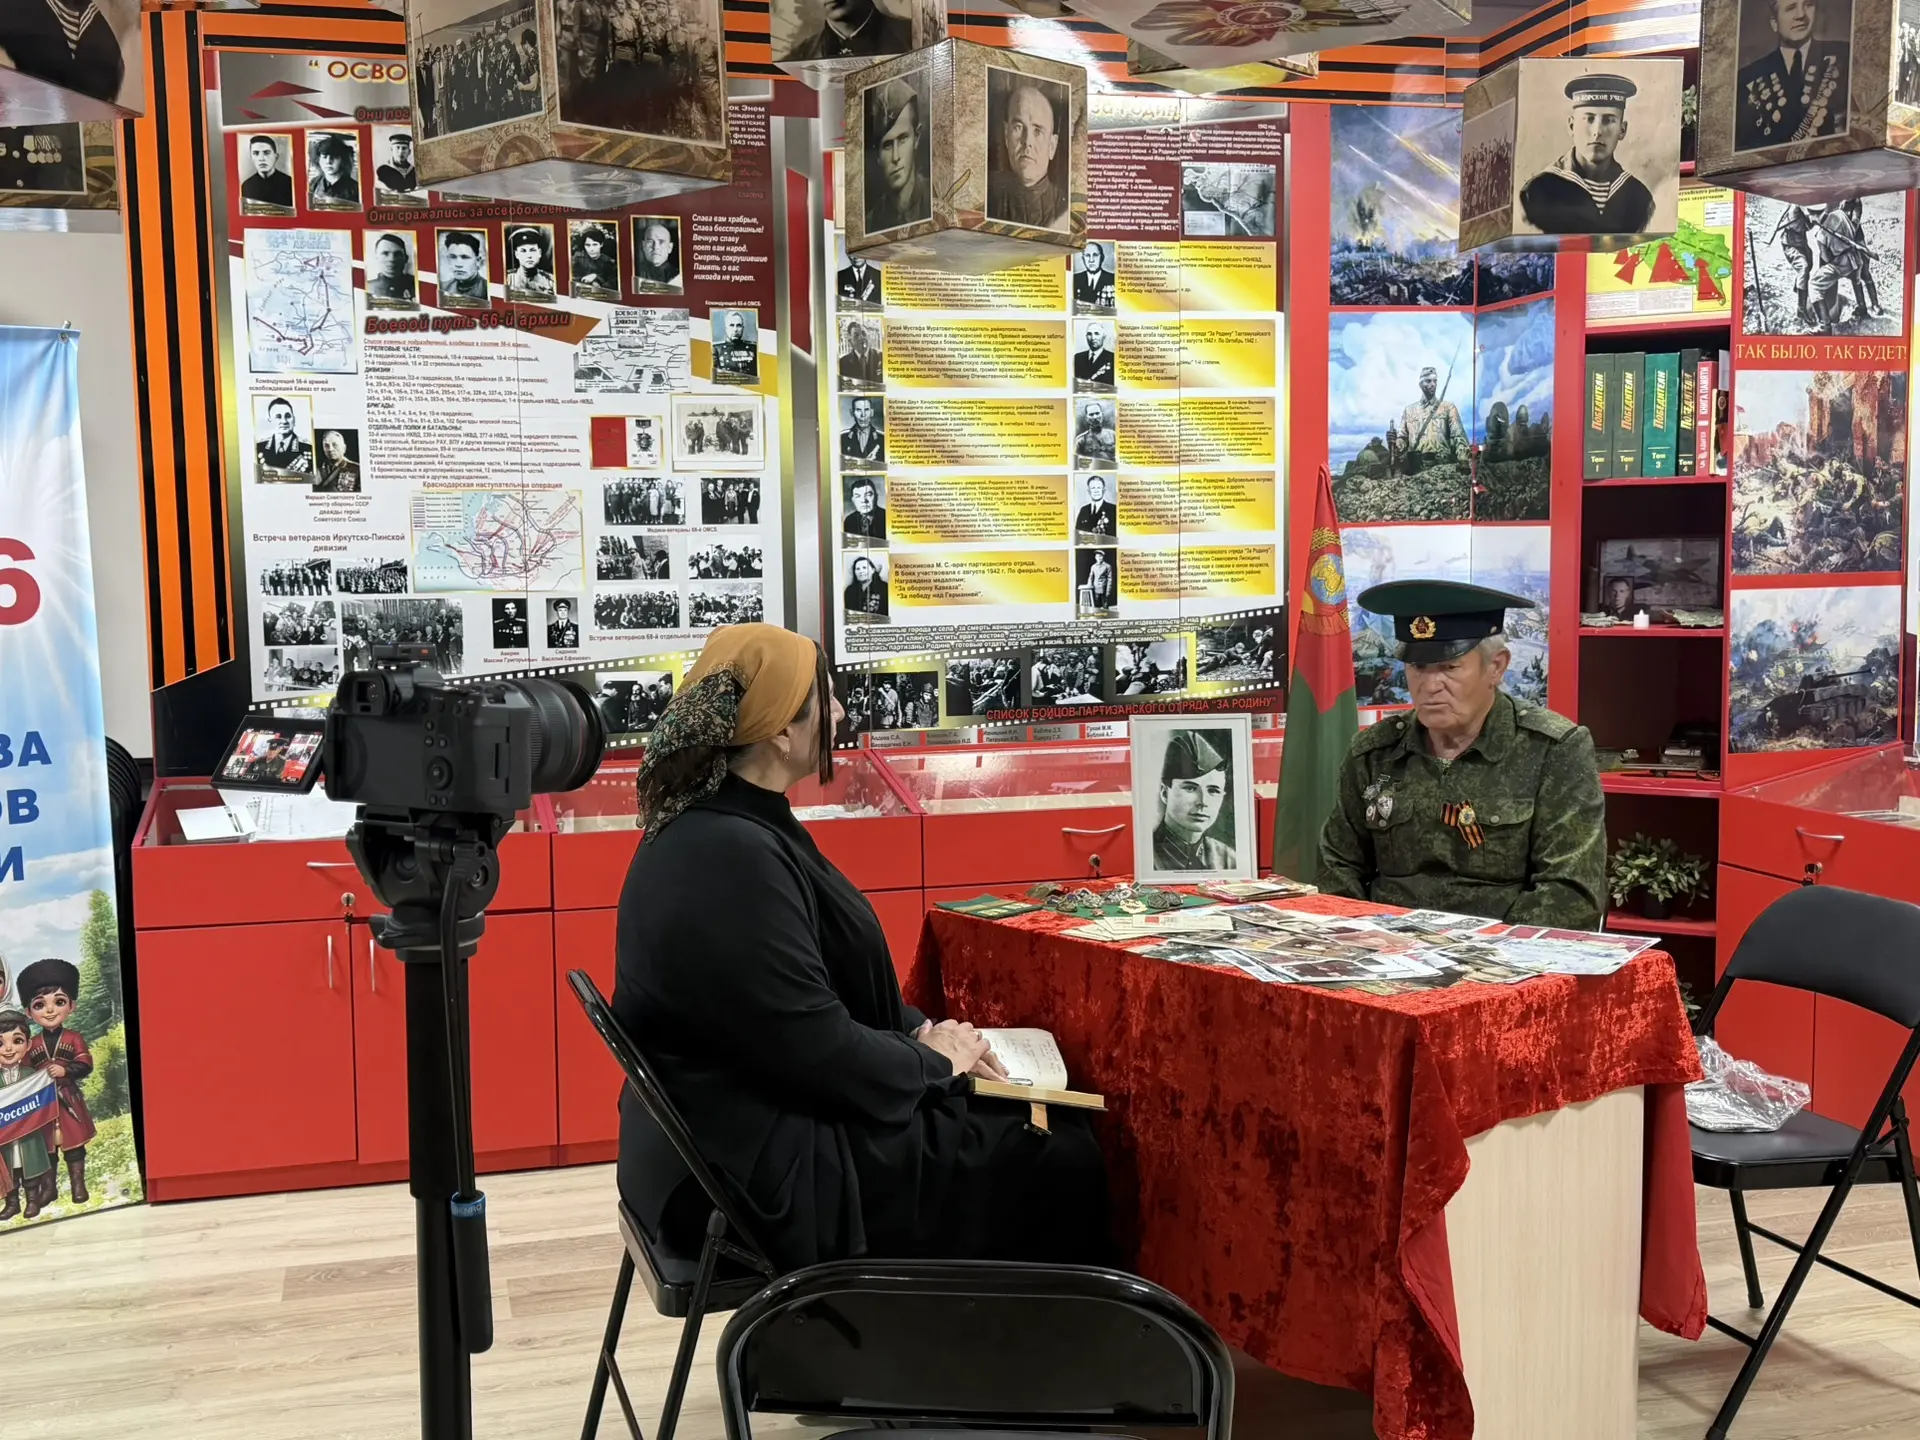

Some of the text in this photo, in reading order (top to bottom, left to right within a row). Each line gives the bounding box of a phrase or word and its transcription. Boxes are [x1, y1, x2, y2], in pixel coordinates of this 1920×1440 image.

[366, 312, 570, 334] Боевой путь 56-й армии
[1736, 343, 1907, 361] ТАК БЫЛО. ТАК БУДЕТ!
[1700, 366, 1708, 414] КНИГА ПАМЯТИ
[253, 534, 286, 542] Встреча
[333, 533, 405, 542] Иркутско-Пинской
[986, 697, 1276, 721] СПИСОК БОЙЦОВ ПАРТИЗАНСКОГО ОТРЯДА "ЗА РОДИНУ"
